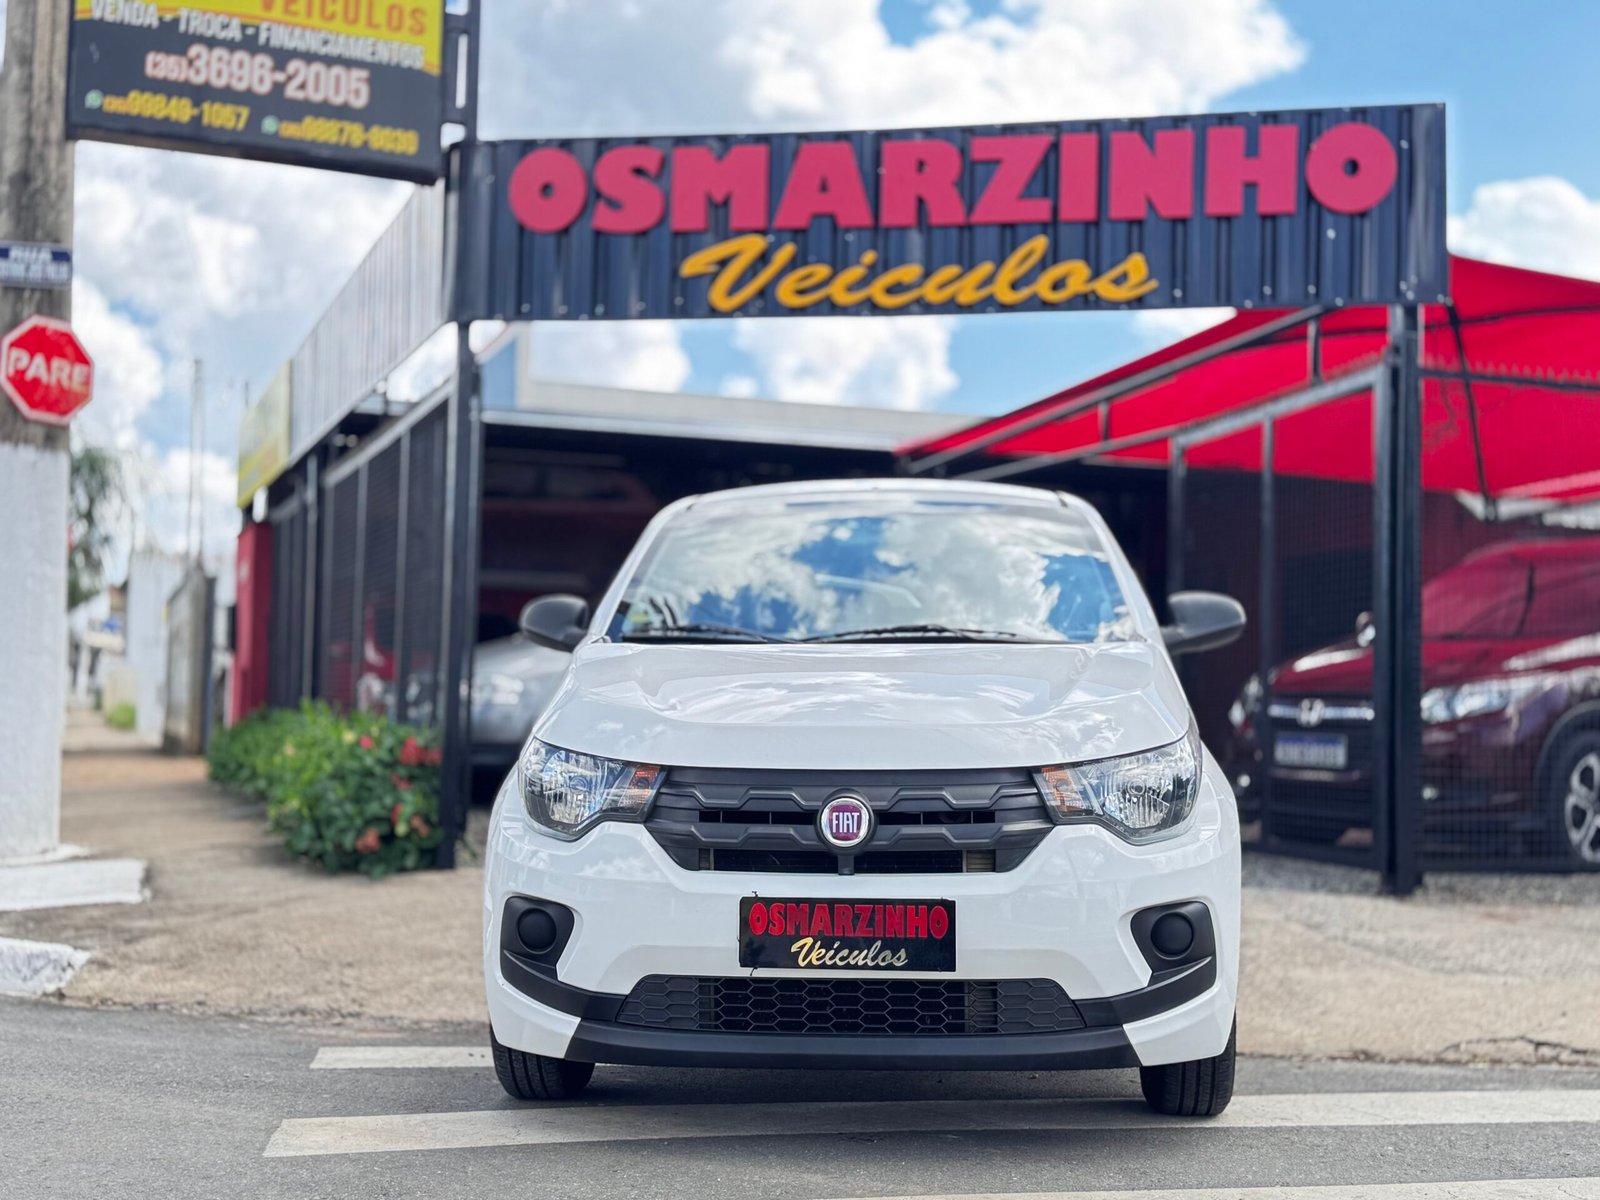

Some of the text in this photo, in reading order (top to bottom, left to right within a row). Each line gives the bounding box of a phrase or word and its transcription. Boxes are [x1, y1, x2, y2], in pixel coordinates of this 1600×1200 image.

[90, 0, 160, 29] VENDA
[177, 7, 243, 42] TROCA
[508, 122, 1398, 233] OSMARZINHO
[7, 346, 89, 393] PARE
[832, 811, 860, 833] FIAT
[749, 902, 948, 939] OSMARZINHO
